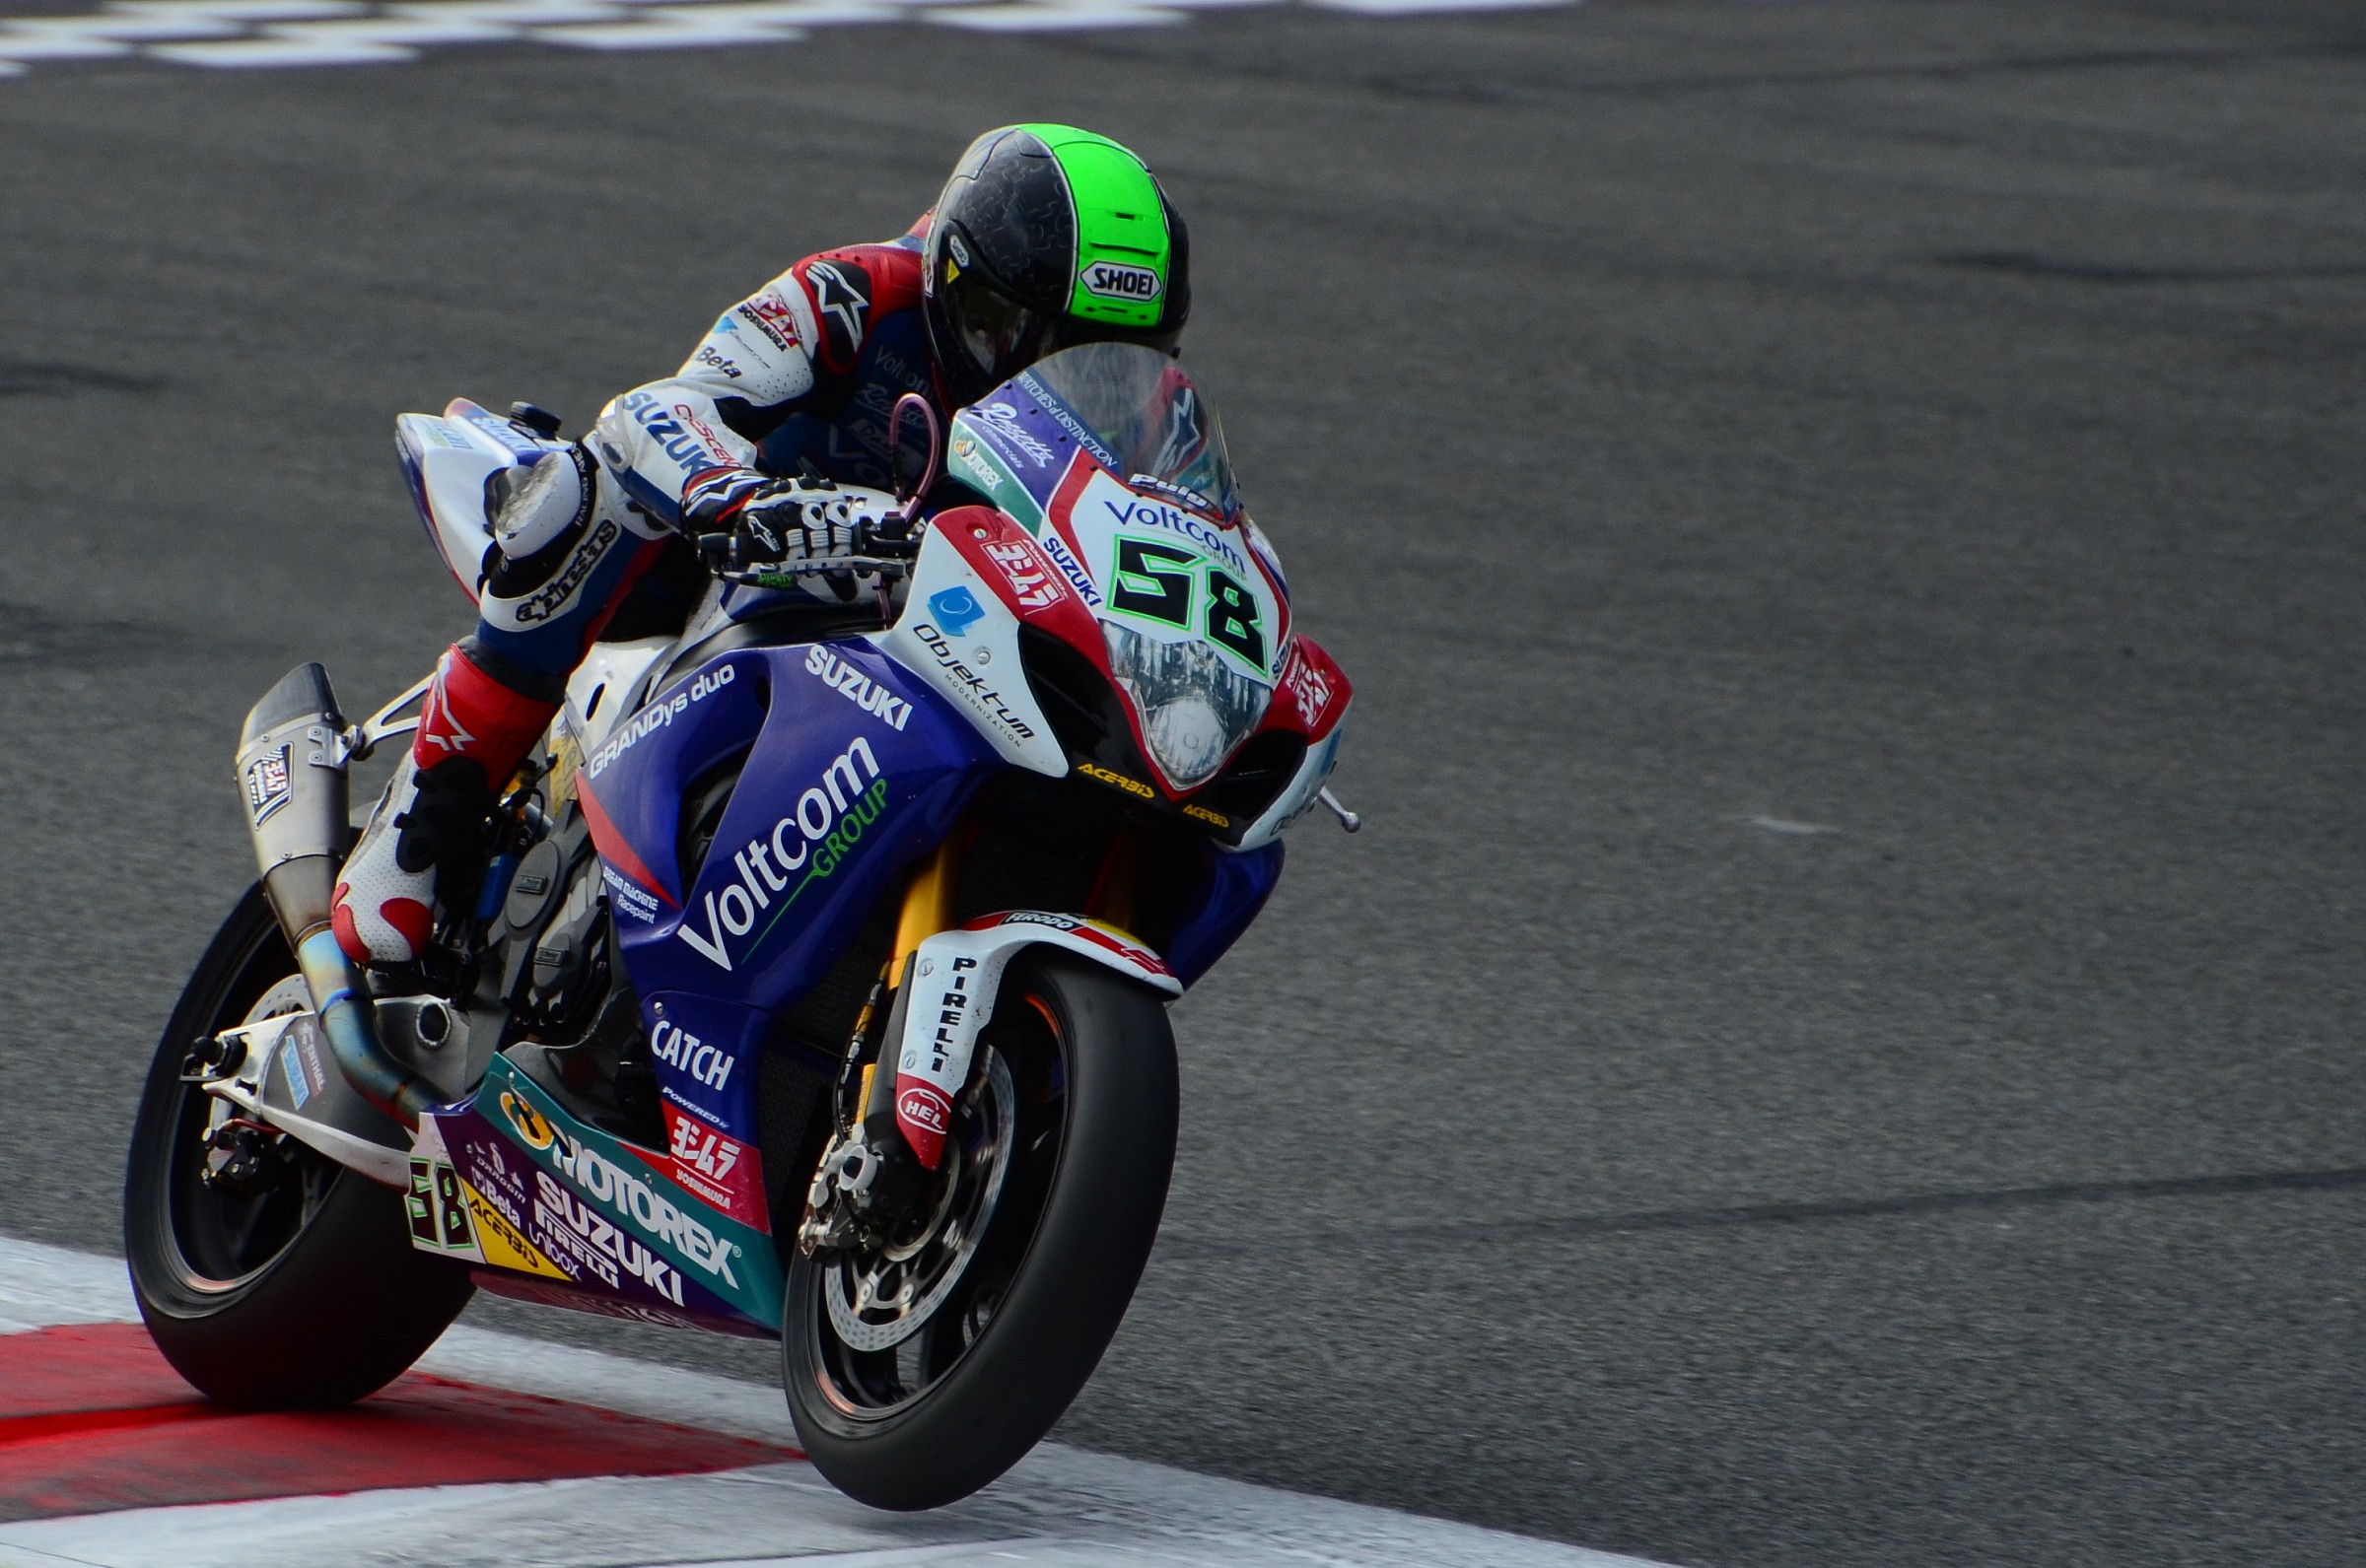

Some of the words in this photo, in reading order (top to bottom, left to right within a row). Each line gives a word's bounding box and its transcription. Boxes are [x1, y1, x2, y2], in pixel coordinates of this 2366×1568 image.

[1093, 267, 1153, 295] SHOEI
[696, 347, 742, 379] Beta
[737, 305, 788, 353] YOSHIMURA
[624, 392, 717, 474] SUZUK
[1056, 411, 1118, 468] DISTINCTION
[574, 476, 590, 527] RACING
[516, 518, 618, 622] alpinestars
[1043, 537, 1103, 607] SUZUKI
[1103, 501, 1246, 573] Voltcom
[1201, 544, 1248, 581] GROUP
[1106, 533, 1269, 679] 58
[590, 690, 688, 780] GRANDys
[691, 663, 736, 704] duo
[804, 644, 914, 731] SUZUKI
[944, 674, 1022, 749] MODERNIZATION
[677, 735, 881, 973] Voltcom
[812, 778, 888, 877] GROUP
[617, 893, 656, 924] Racepaint
[622, 881, 660, 912] MACHINE
[1006, 912, 1075, 929] FERODO
[932, 956, 978, 1072] PIRELLI
[651, 1020, 735, 1091] CATCH
[661, 1086, 721, 1125] POWERED
[905, 1100, 943, 1130] HEL
[408, 1156, 476, 1251] 58
[483, 1178, 522, 1231] Beta
[675, 1168, 731, 1210] YOSHIMURA
[533, 1196, 620, 1290] PIRELLI
[536, 1170, 686, 1308] SUZUKI
